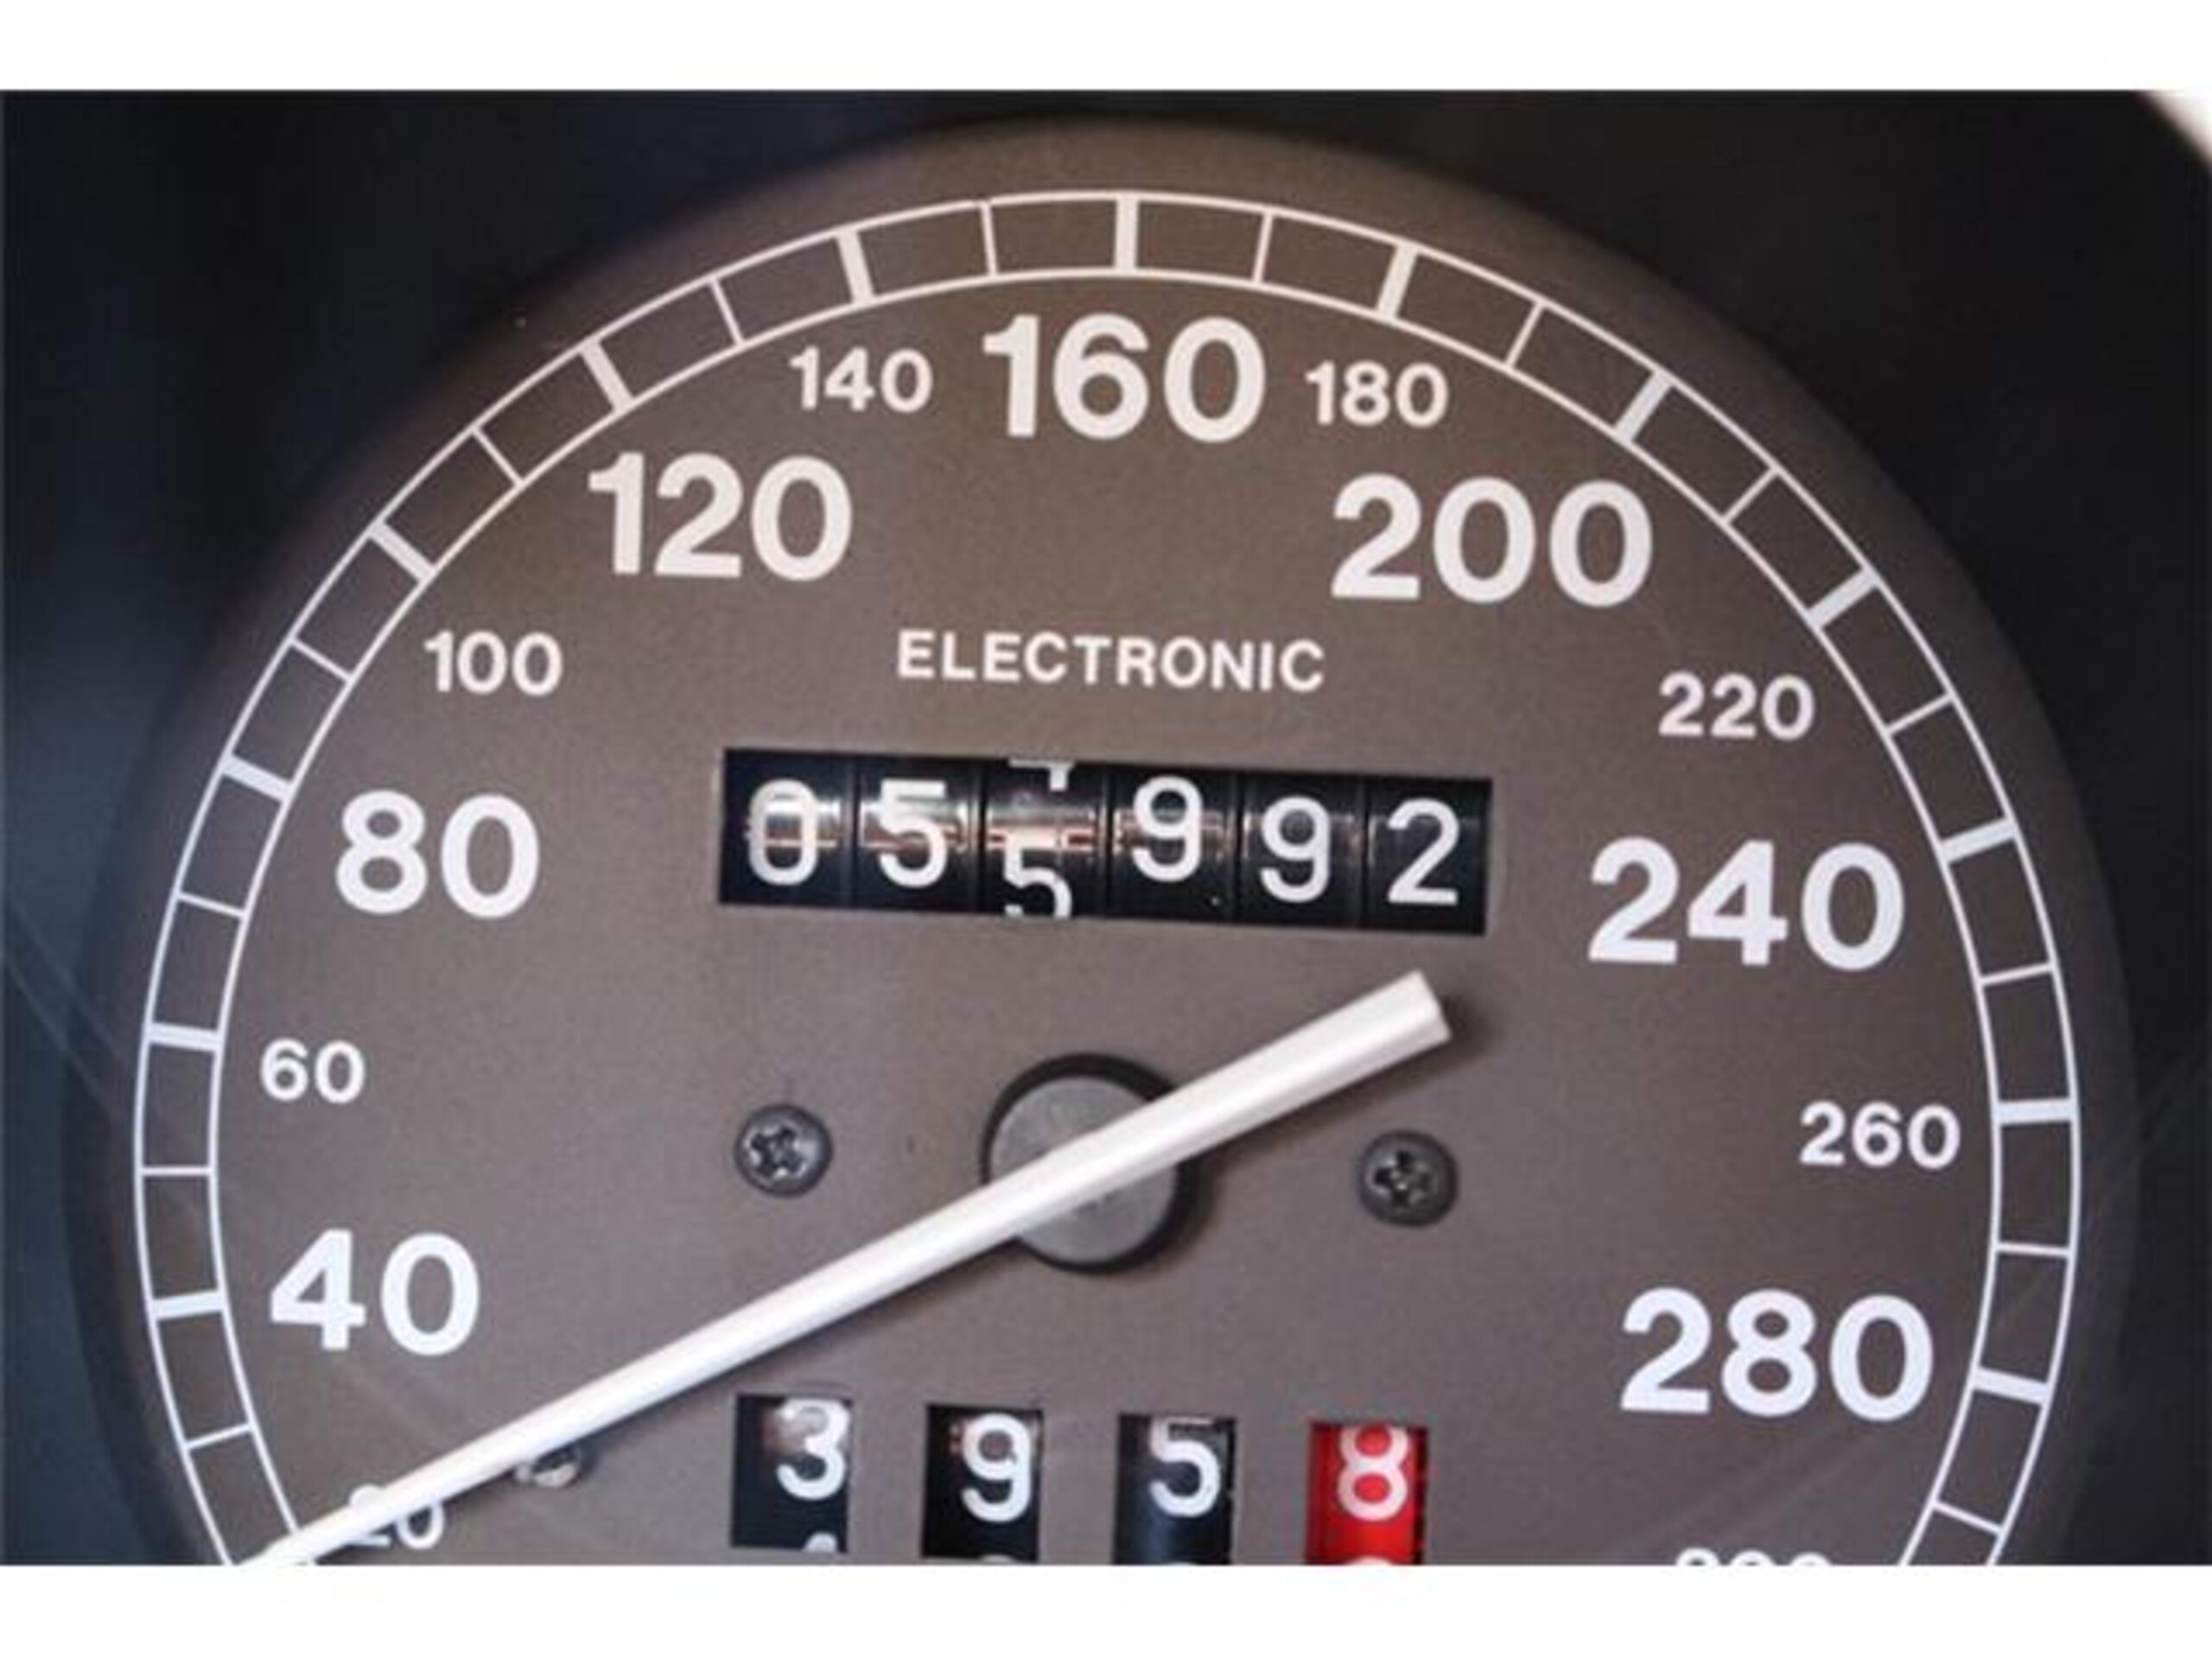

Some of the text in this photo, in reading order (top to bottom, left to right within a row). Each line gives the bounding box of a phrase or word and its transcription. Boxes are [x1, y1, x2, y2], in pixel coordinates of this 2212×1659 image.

[790, 346, 932, 413] 140
[983, 314, 1265, 442] 160
[1306, 361, 1448, 427] 180
[589, 453, 852, 582] 120
[1332, 474, 1651, 607] 200
[424, 631, 563, 696] 100
[897, 629, 1324, 692] ELECTRONIC
[1659, 671, 1814, 740] 220
[336, 790, 539, 918] 80
[1588, 836, 1904, 970] 240
[261, 1039, 365, 1103] 60
[1800, 1101, 1960, 1169] 260
[271, 1230, 480, 1356] 40
[1621, 1287, 1932, 1421] 280
